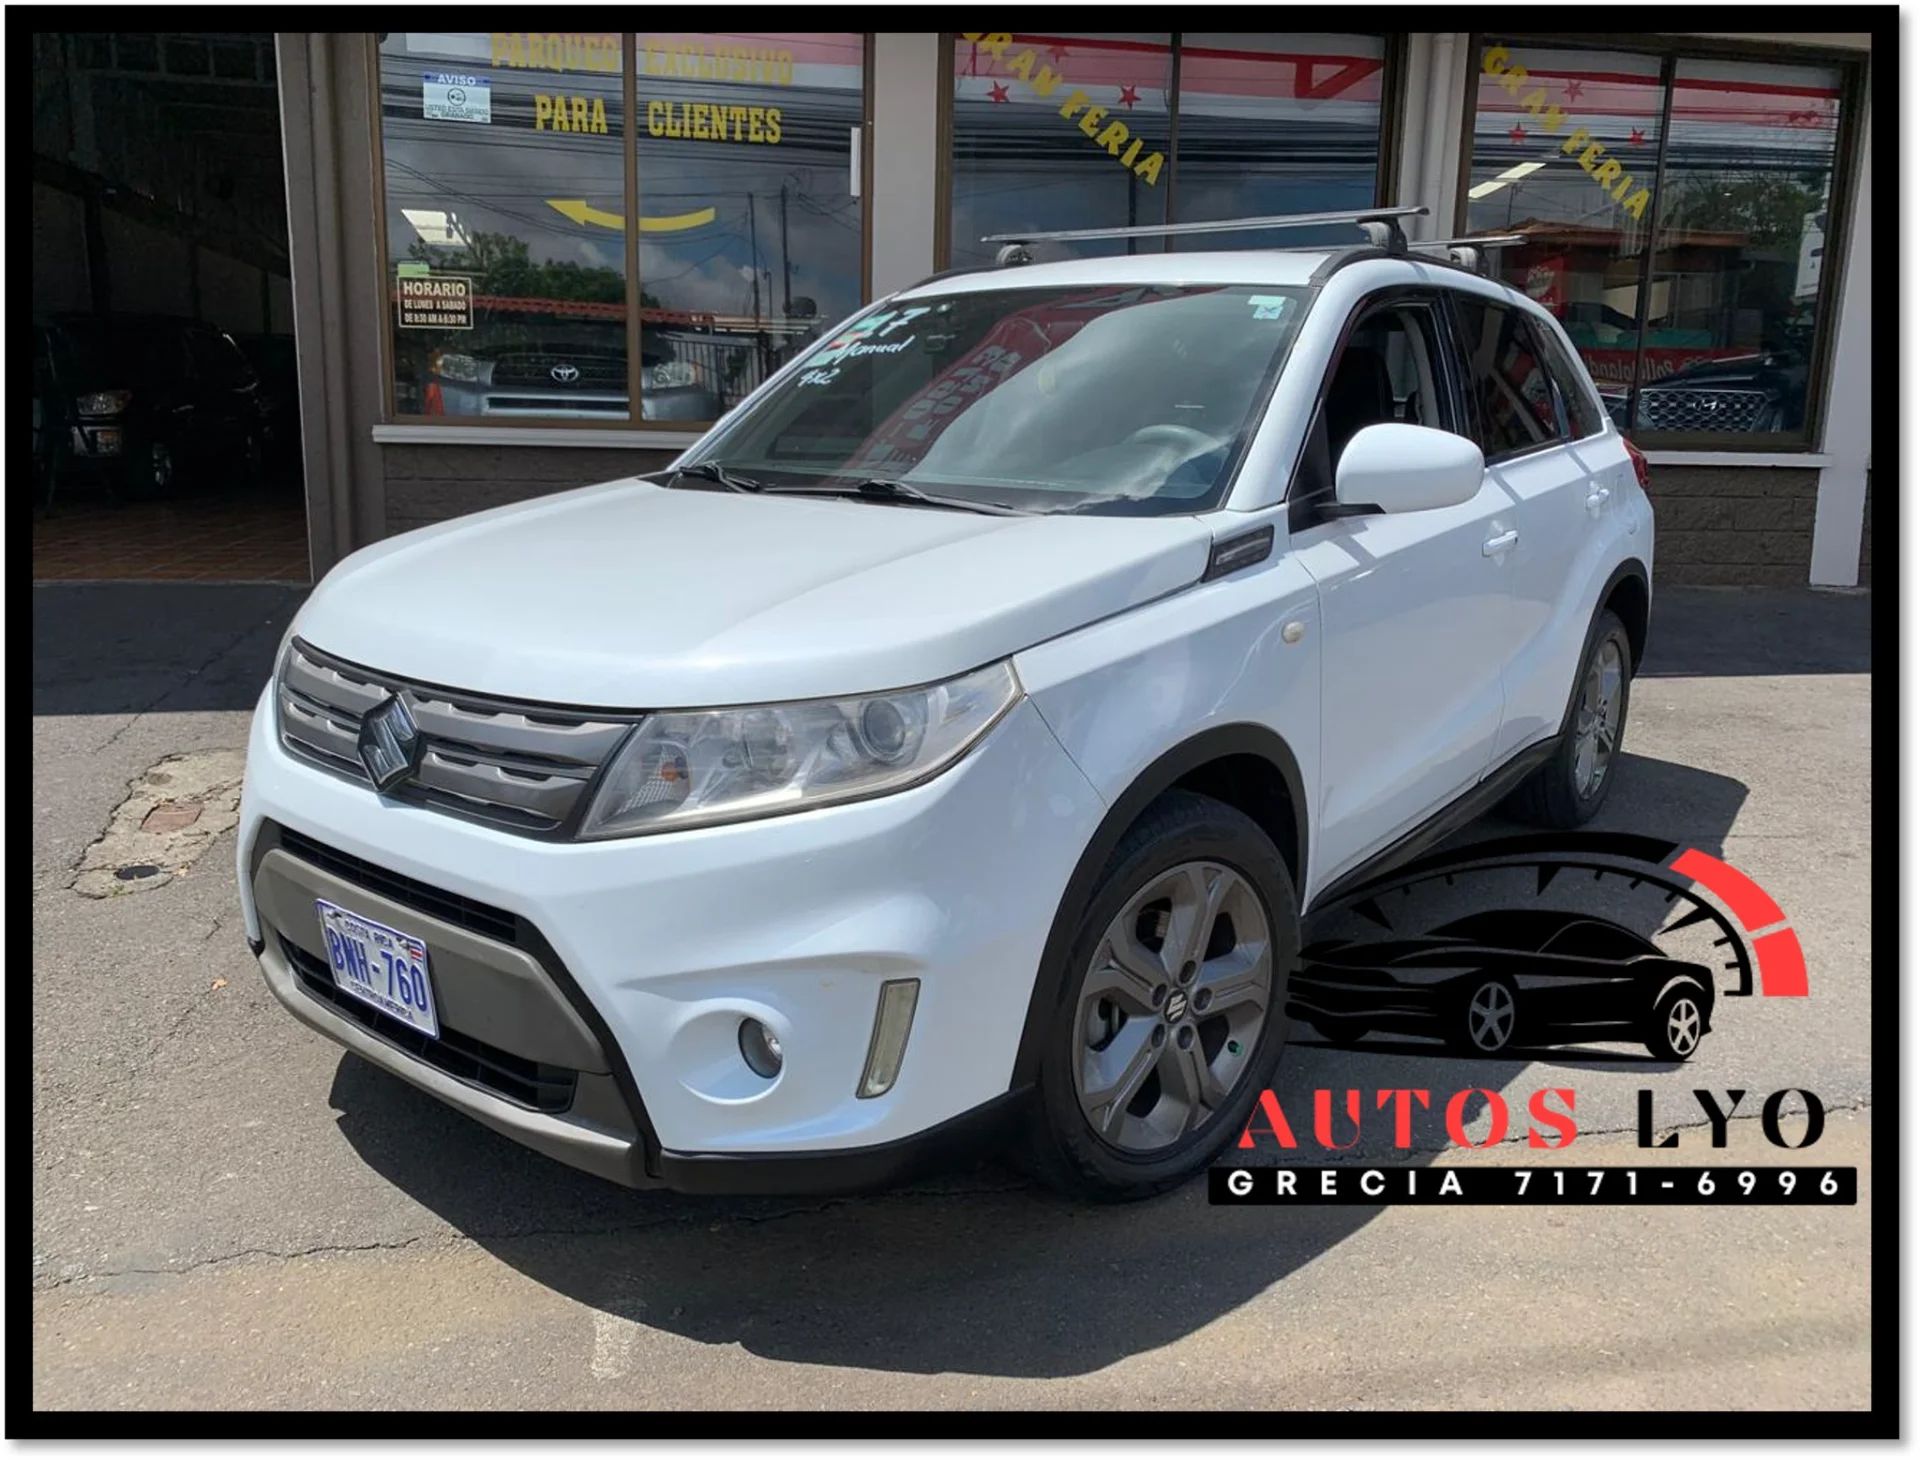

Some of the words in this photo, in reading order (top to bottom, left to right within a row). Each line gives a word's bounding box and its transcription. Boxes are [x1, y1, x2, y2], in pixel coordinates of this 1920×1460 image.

[438, 73, 477, 87] AVISO
[492, 33, 619, 72] PARQUEO
[645, 39, 793, 86] EXCLUSIVO
[534, 95, 608, 134] PARA
[648, 101, 782, 144] CLIENTES
[1059, 90, 1165, 185] FERIA
[1562, 128, 1650, 220] FERIA
[403, 281, 467, 297] HORARIO
[326, 927, 427, 1012] BNH-760
